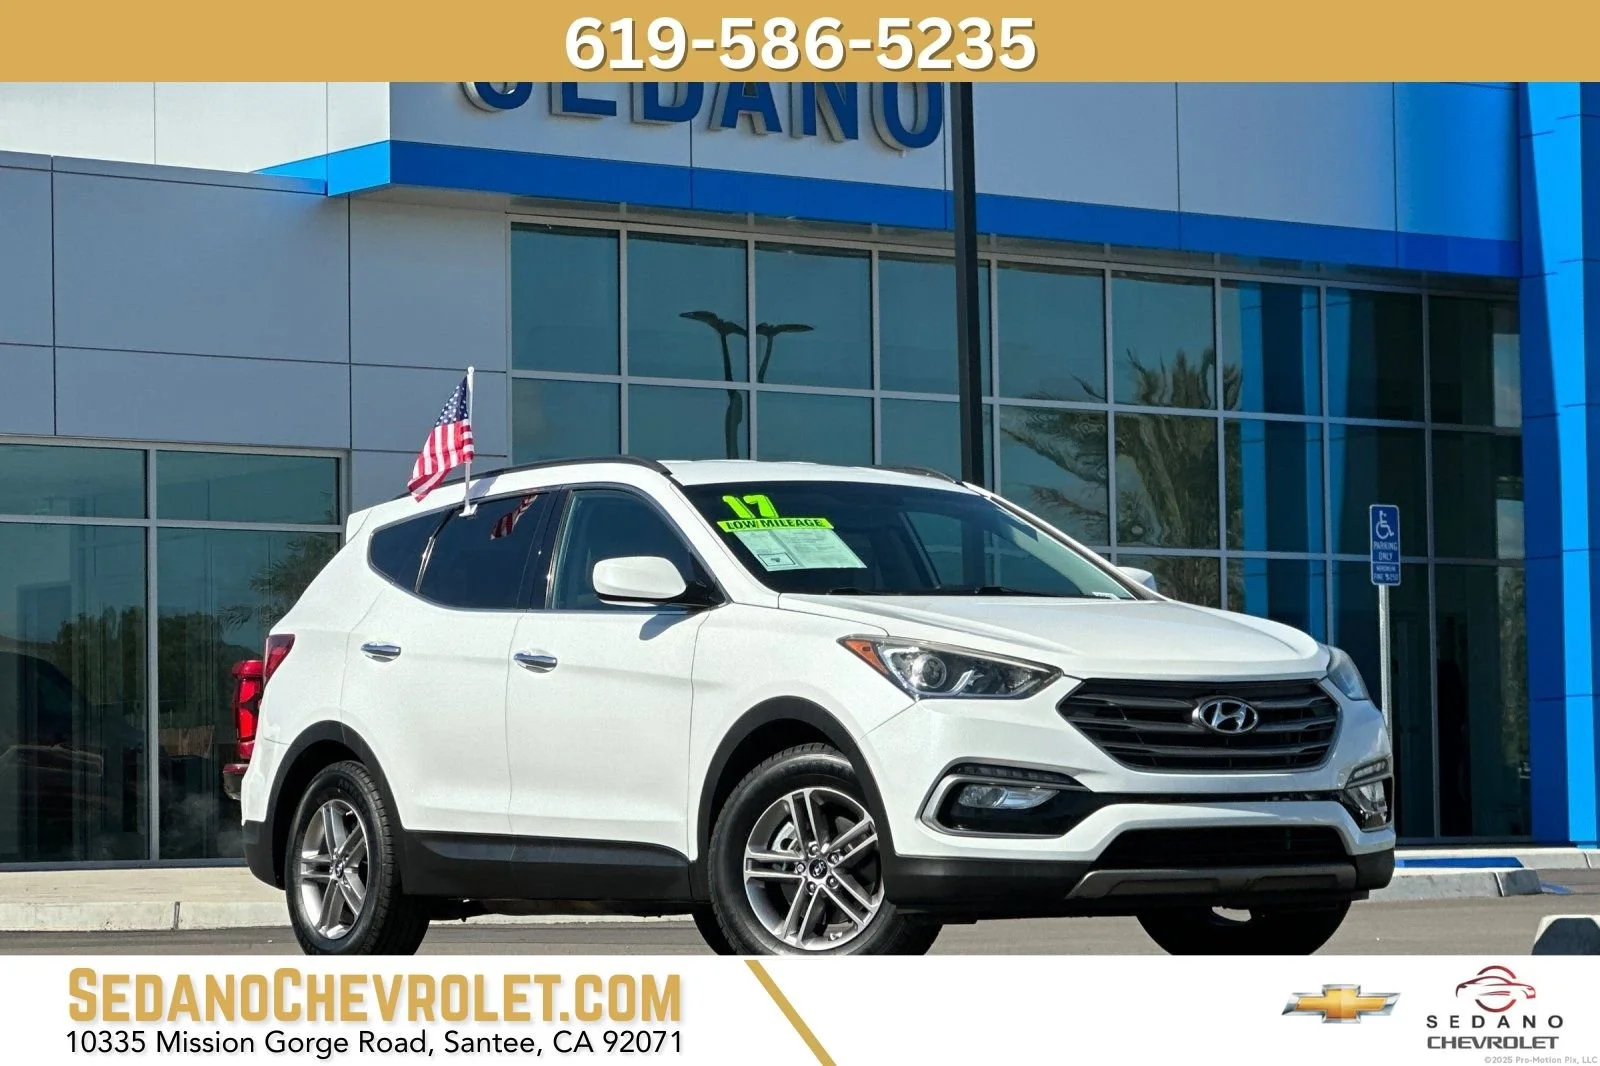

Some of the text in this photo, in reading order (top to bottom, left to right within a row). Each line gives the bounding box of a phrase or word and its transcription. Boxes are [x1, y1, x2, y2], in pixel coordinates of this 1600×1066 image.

[722, 494, 779, 519] 17
[726, 518, 825, 530] LOW MILEAGE
[1373, 541, 1398, 551] PARKING
[1378, 551, 1393, 561] ONLY
